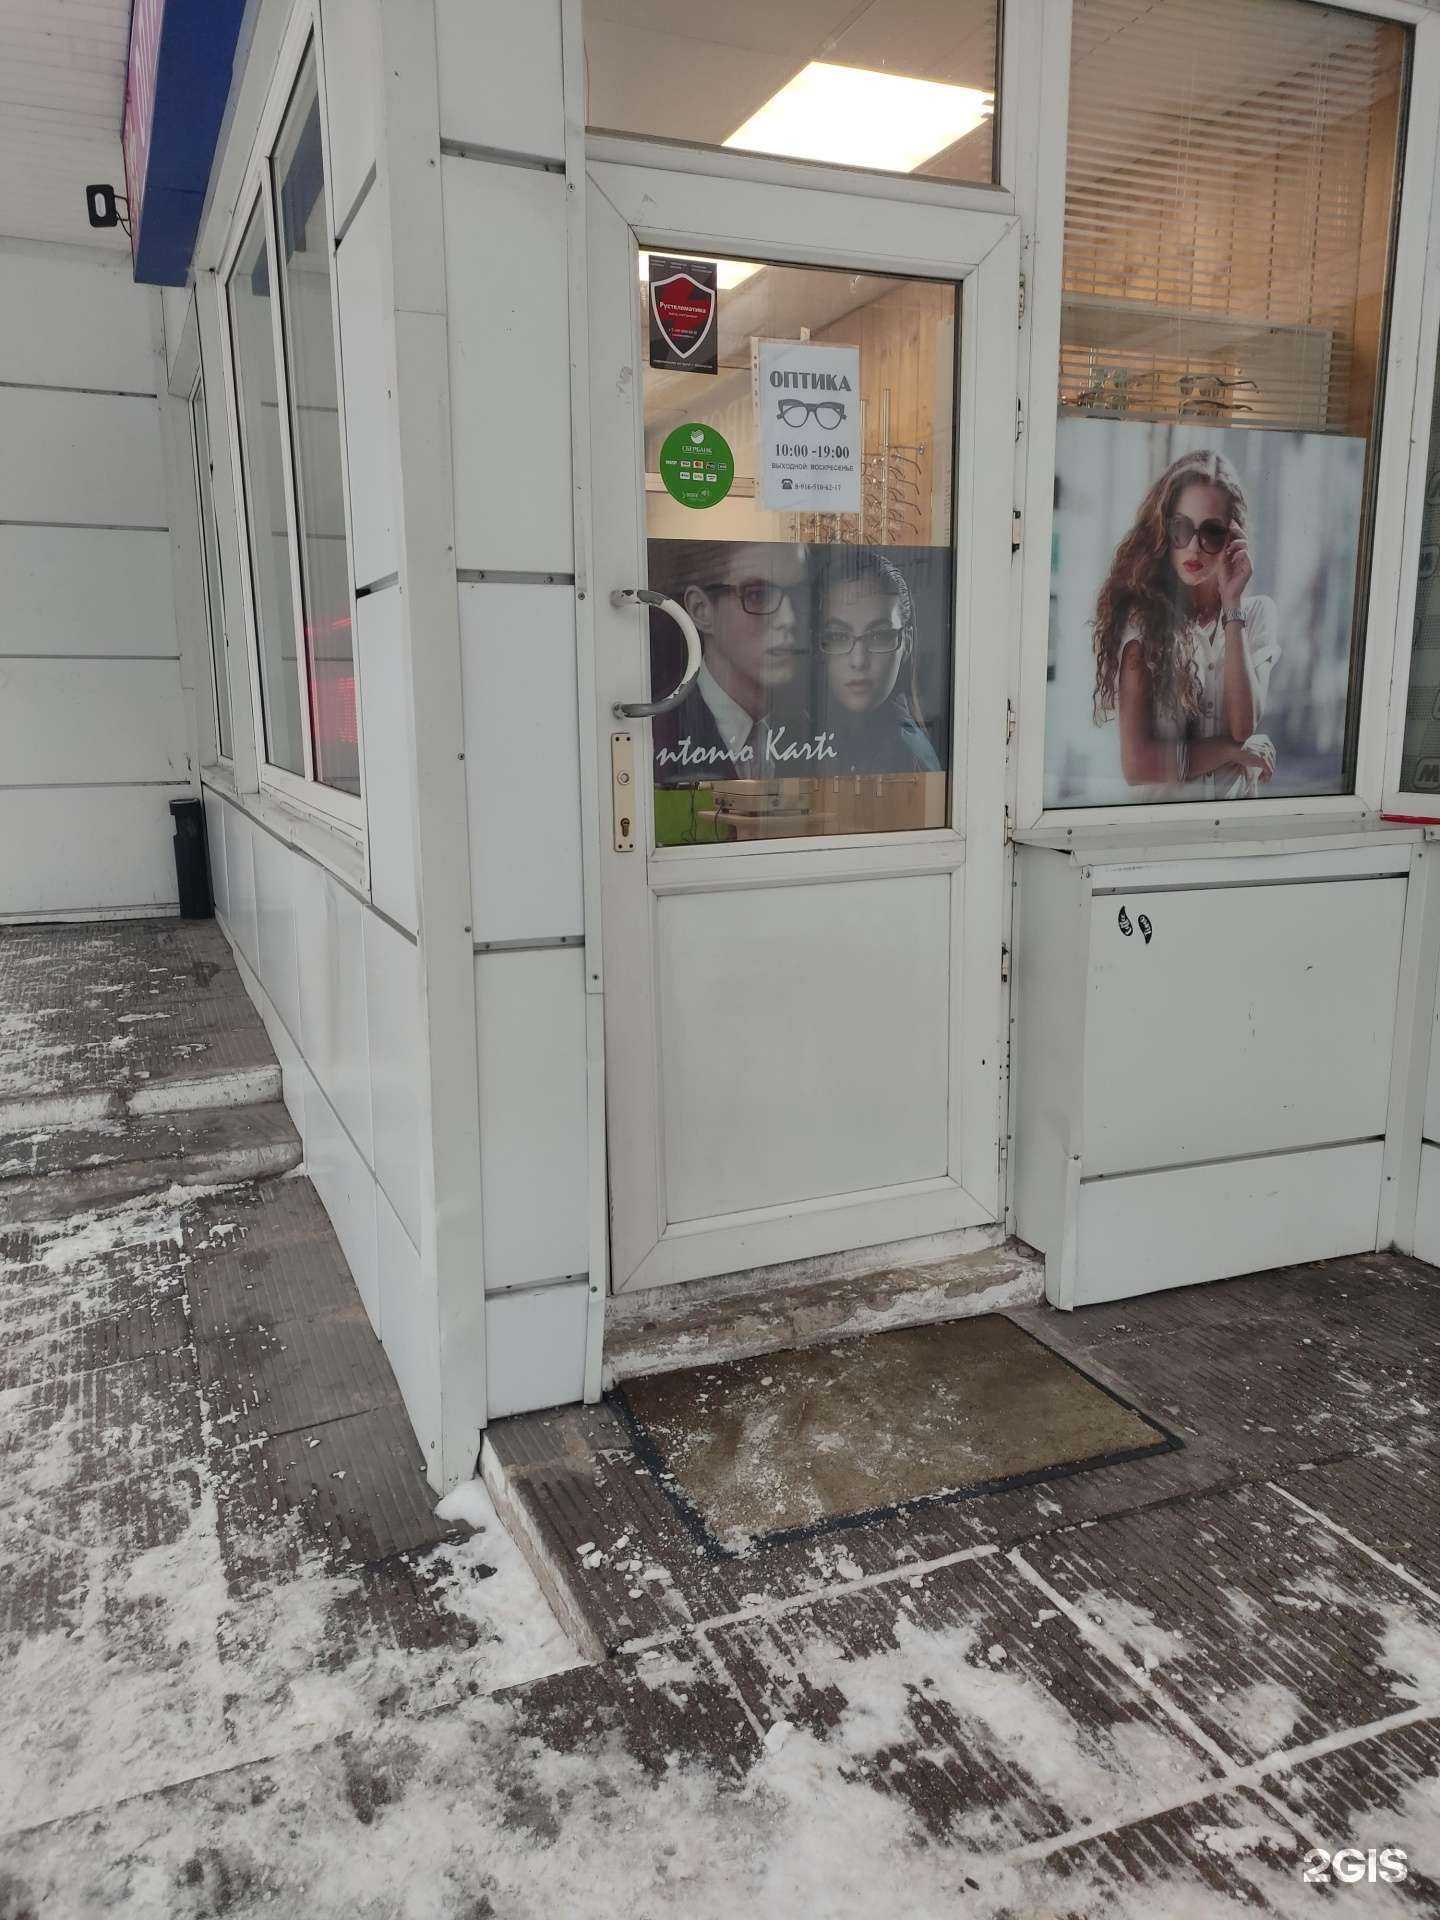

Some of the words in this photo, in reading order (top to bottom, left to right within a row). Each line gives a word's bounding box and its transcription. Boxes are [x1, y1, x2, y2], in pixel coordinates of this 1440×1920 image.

[769, 370, 852, 392] ОПТИКА
[775, 443, 808, 457] 10:00
[771, 462, 808, 471] ВЫХОДНОЙ
[810, 463, 854, 472] ВОСКРЕСЕНЬЕ
[655, 735, 755, 767] ntonio
[764, 726, 838, 762] Karti
